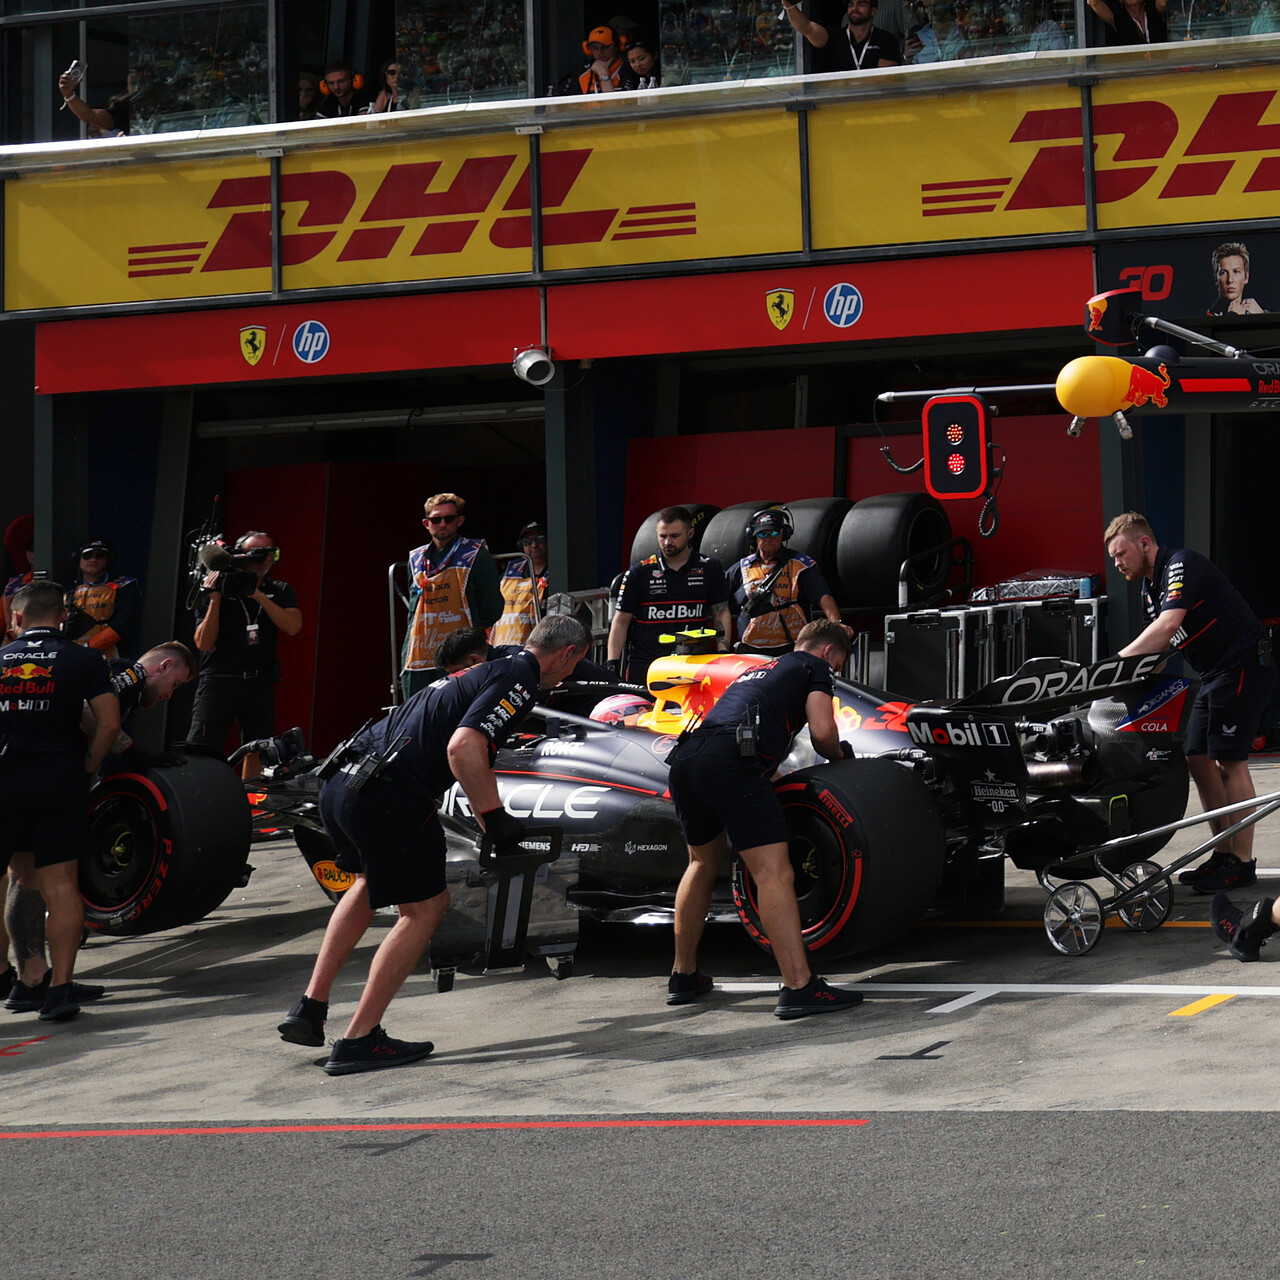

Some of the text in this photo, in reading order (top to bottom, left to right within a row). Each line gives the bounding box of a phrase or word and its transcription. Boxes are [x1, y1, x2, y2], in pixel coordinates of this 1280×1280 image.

[201, 148, 619, 273] DHL
[830, 284, 858, 326] hp
[298, 321, 325, 363] hp
[1258, 380, 1274, 394] Red
[648, 604, 704, 620] Red Bull
[2, 651, 58, 660] ORACLE
[25, 681, 55, 694] Bull
[1002, 654, 1160, 705] ORACLE
[0, 700, 34, 711] Mobil
[907, 722, 982, 746] Mobil
[1140, 722, 1168, 732] COLA
[541, 741, 584, 757] ROKT
[973, 785, 1017, 798] Heineken
[818, 789, 854, 829] PIRELLI
[637, 843, 668, 853] HEXAGON
[323, 867, 352, 885] RAUCH
